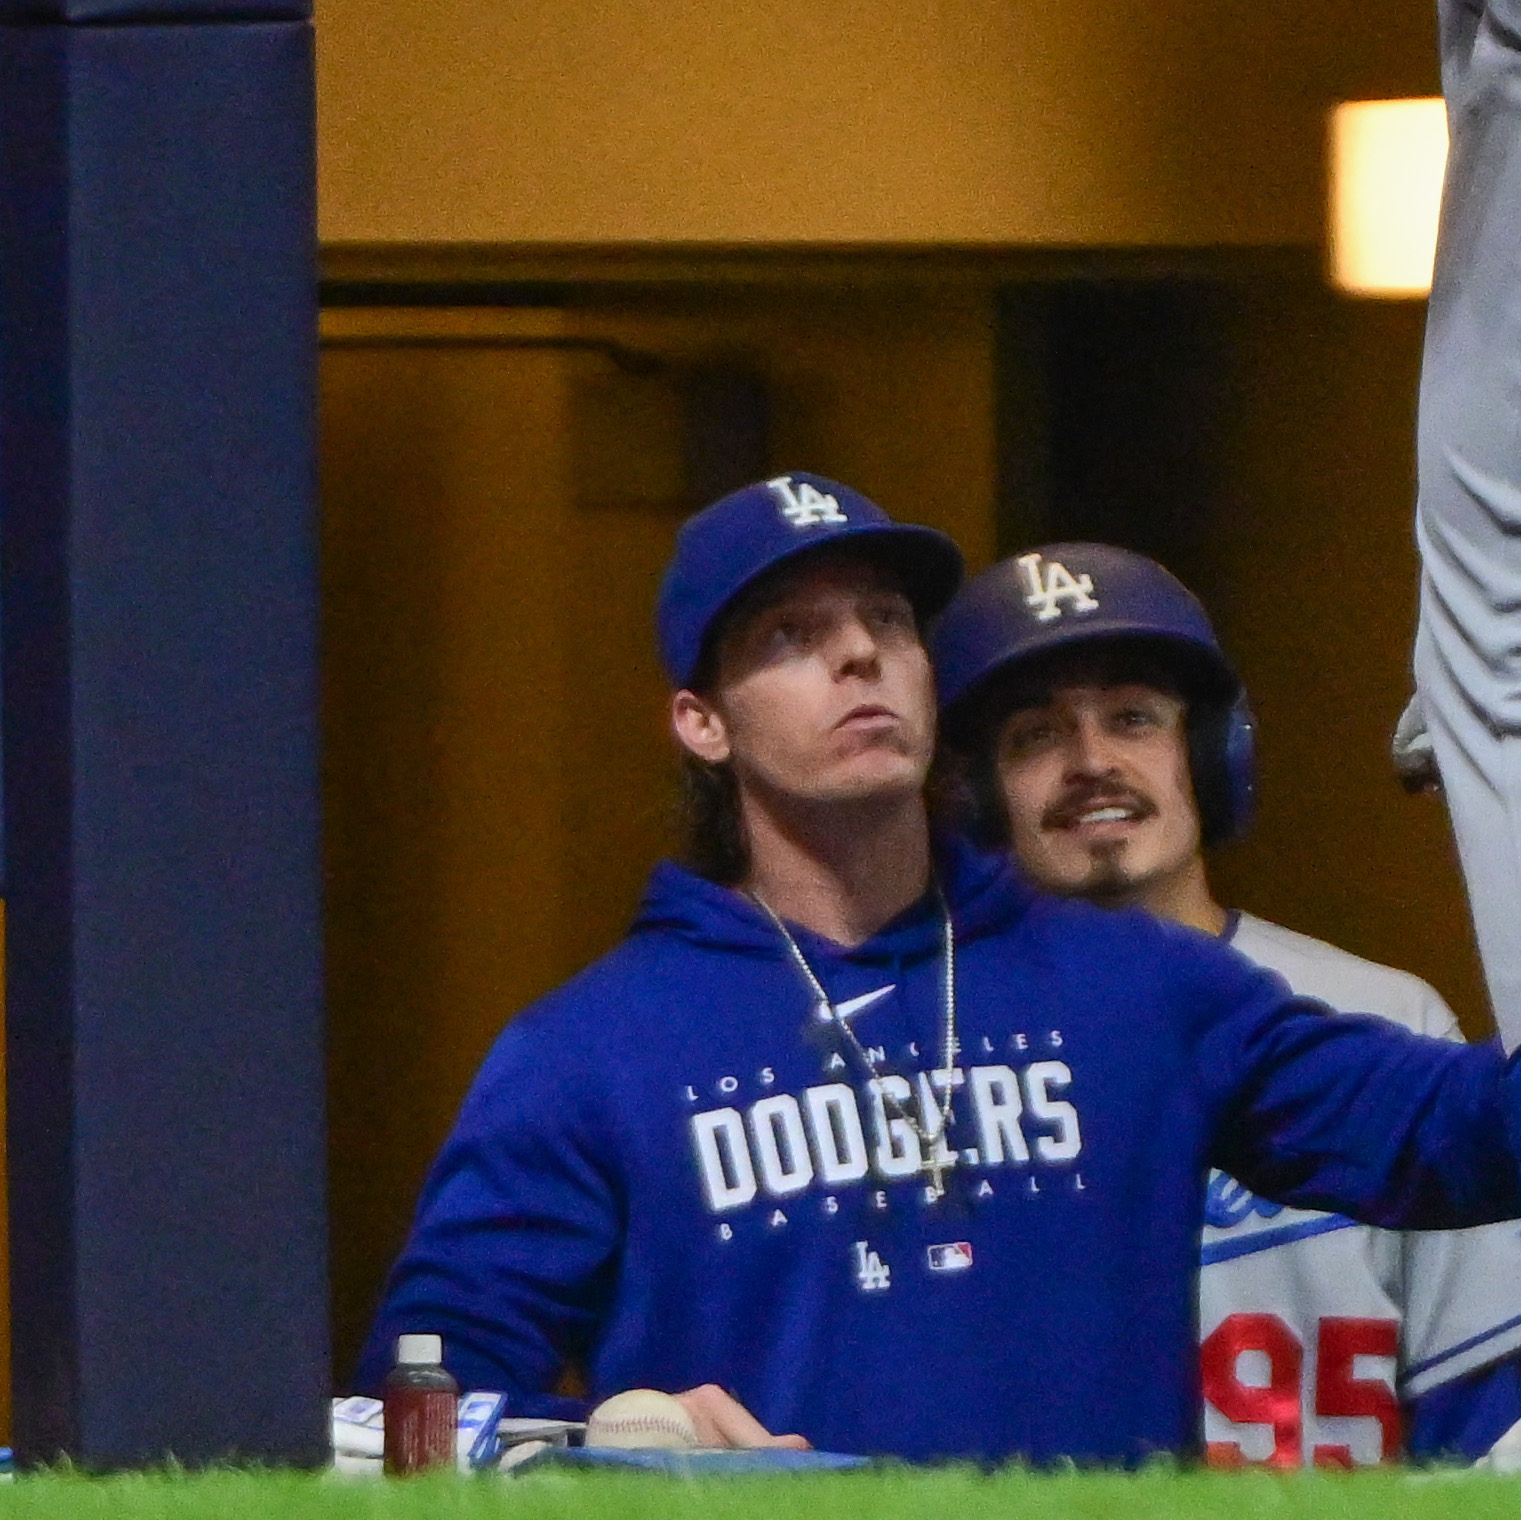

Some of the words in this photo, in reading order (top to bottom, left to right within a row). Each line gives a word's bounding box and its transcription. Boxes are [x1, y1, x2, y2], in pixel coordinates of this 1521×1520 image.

[767, 476, 848, 526] LA
[1018, 553, 1099, 621] LA
[684, 1066, 775, 1102] LOS
[689, 1059, 1083, 1214] DODGERS
[719, 1172, 1087, 1241] BASEBALL
[855, 1239, 892, 1291] LA
[1201, 1312, 1400, 1470] 95
